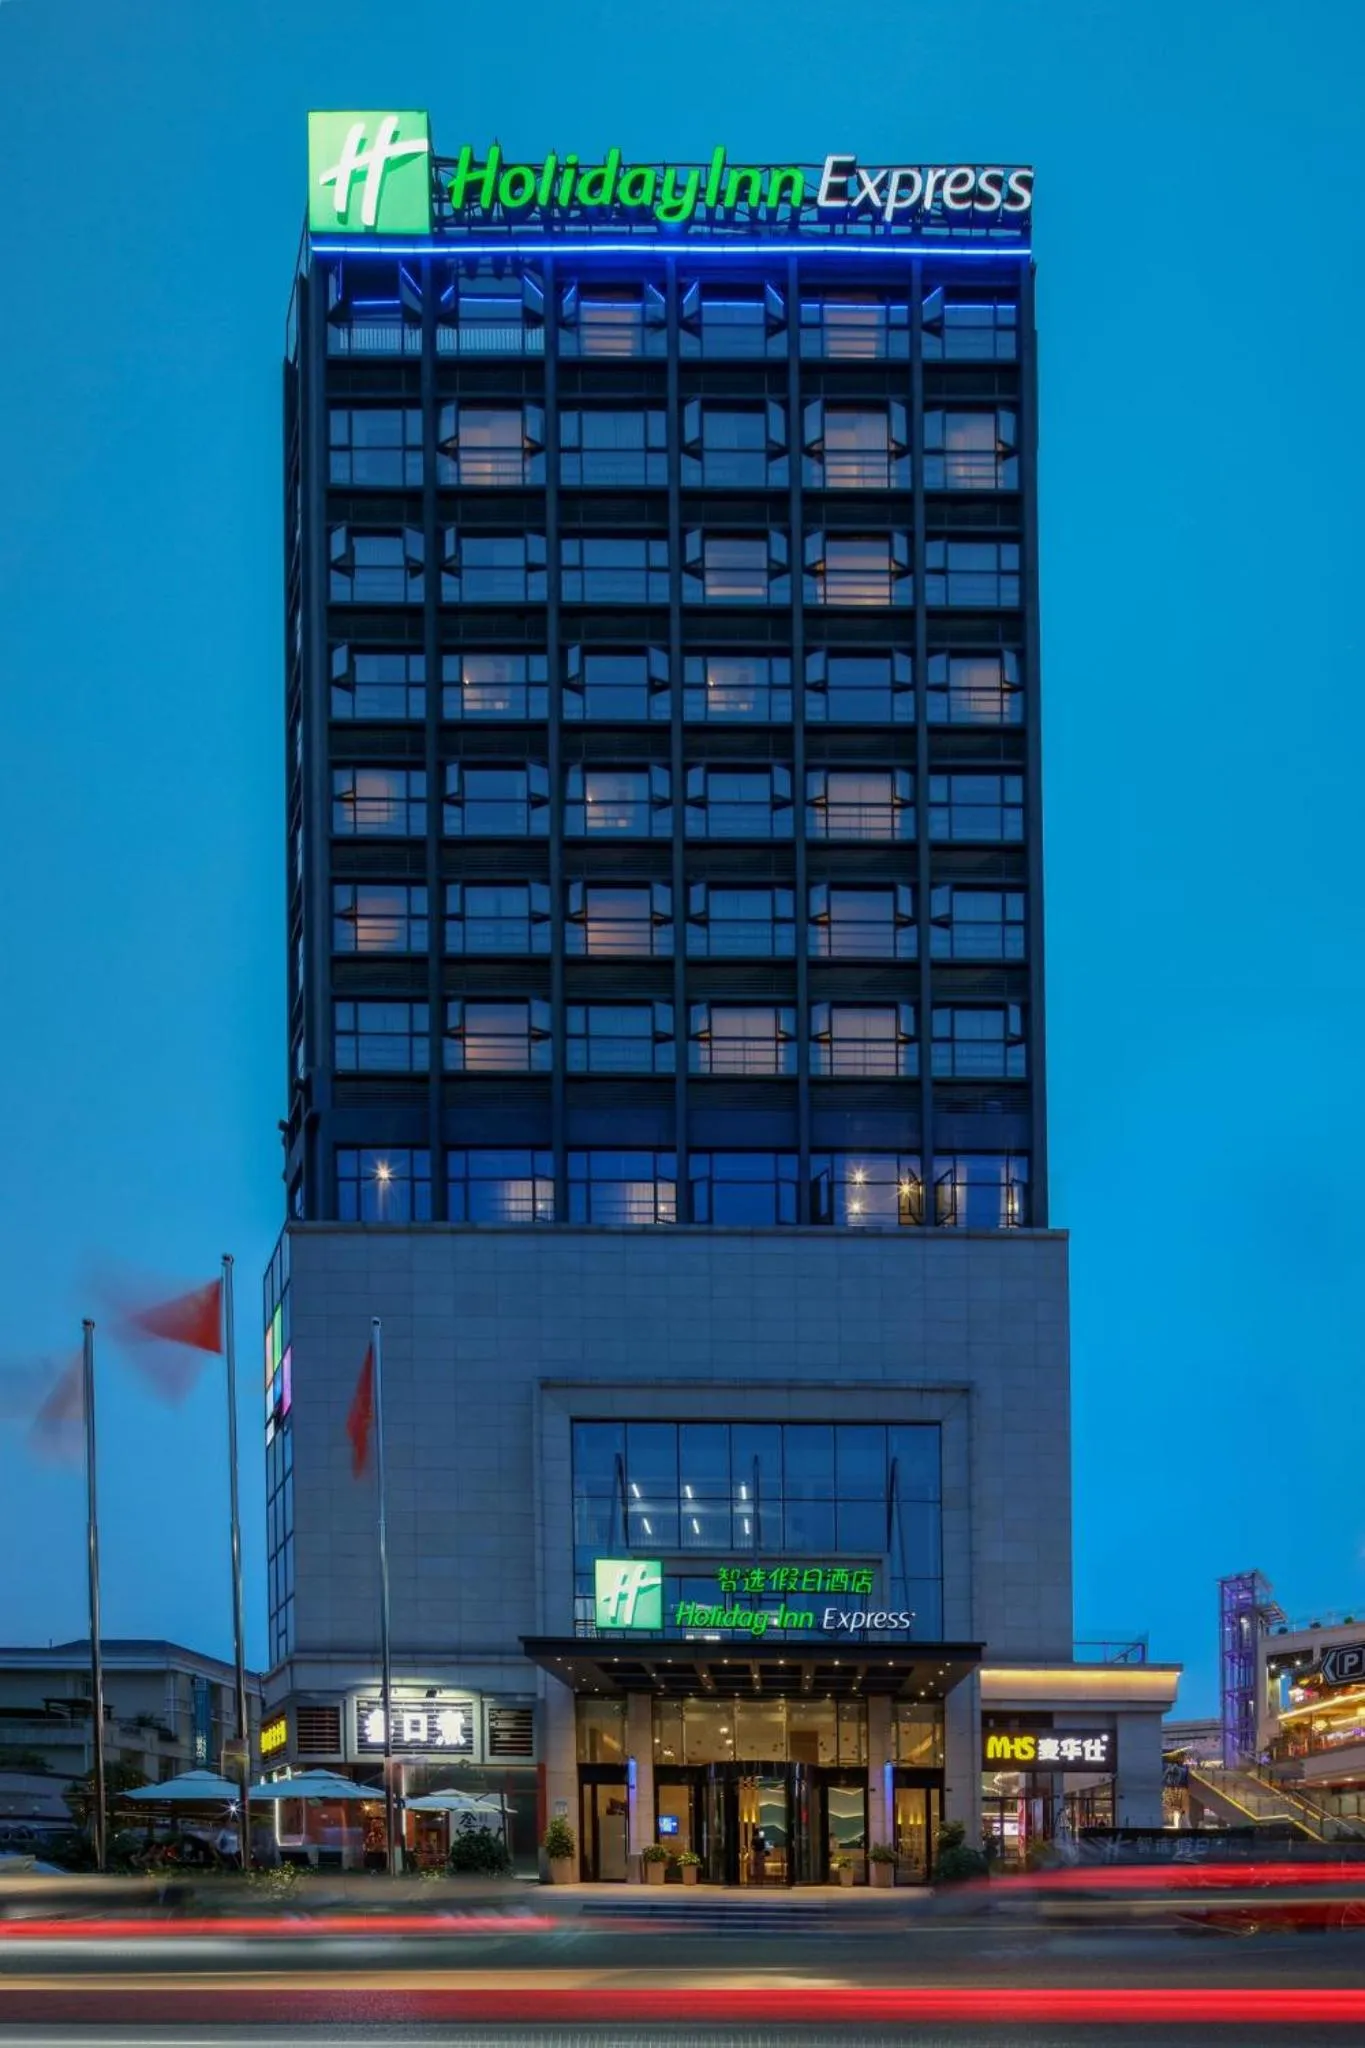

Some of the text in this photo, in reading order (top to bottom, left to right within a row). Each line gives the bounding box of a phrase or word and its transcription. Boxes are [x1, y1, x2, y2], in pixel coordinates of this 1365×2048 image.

[817, 154, 1034, 221] Express
[717, 1566, 874, 1595] 智选假日酒店
[675, 1601, 912, 1637] Holiday Inn Express
[1343, 1652, 1359, 1675] P
